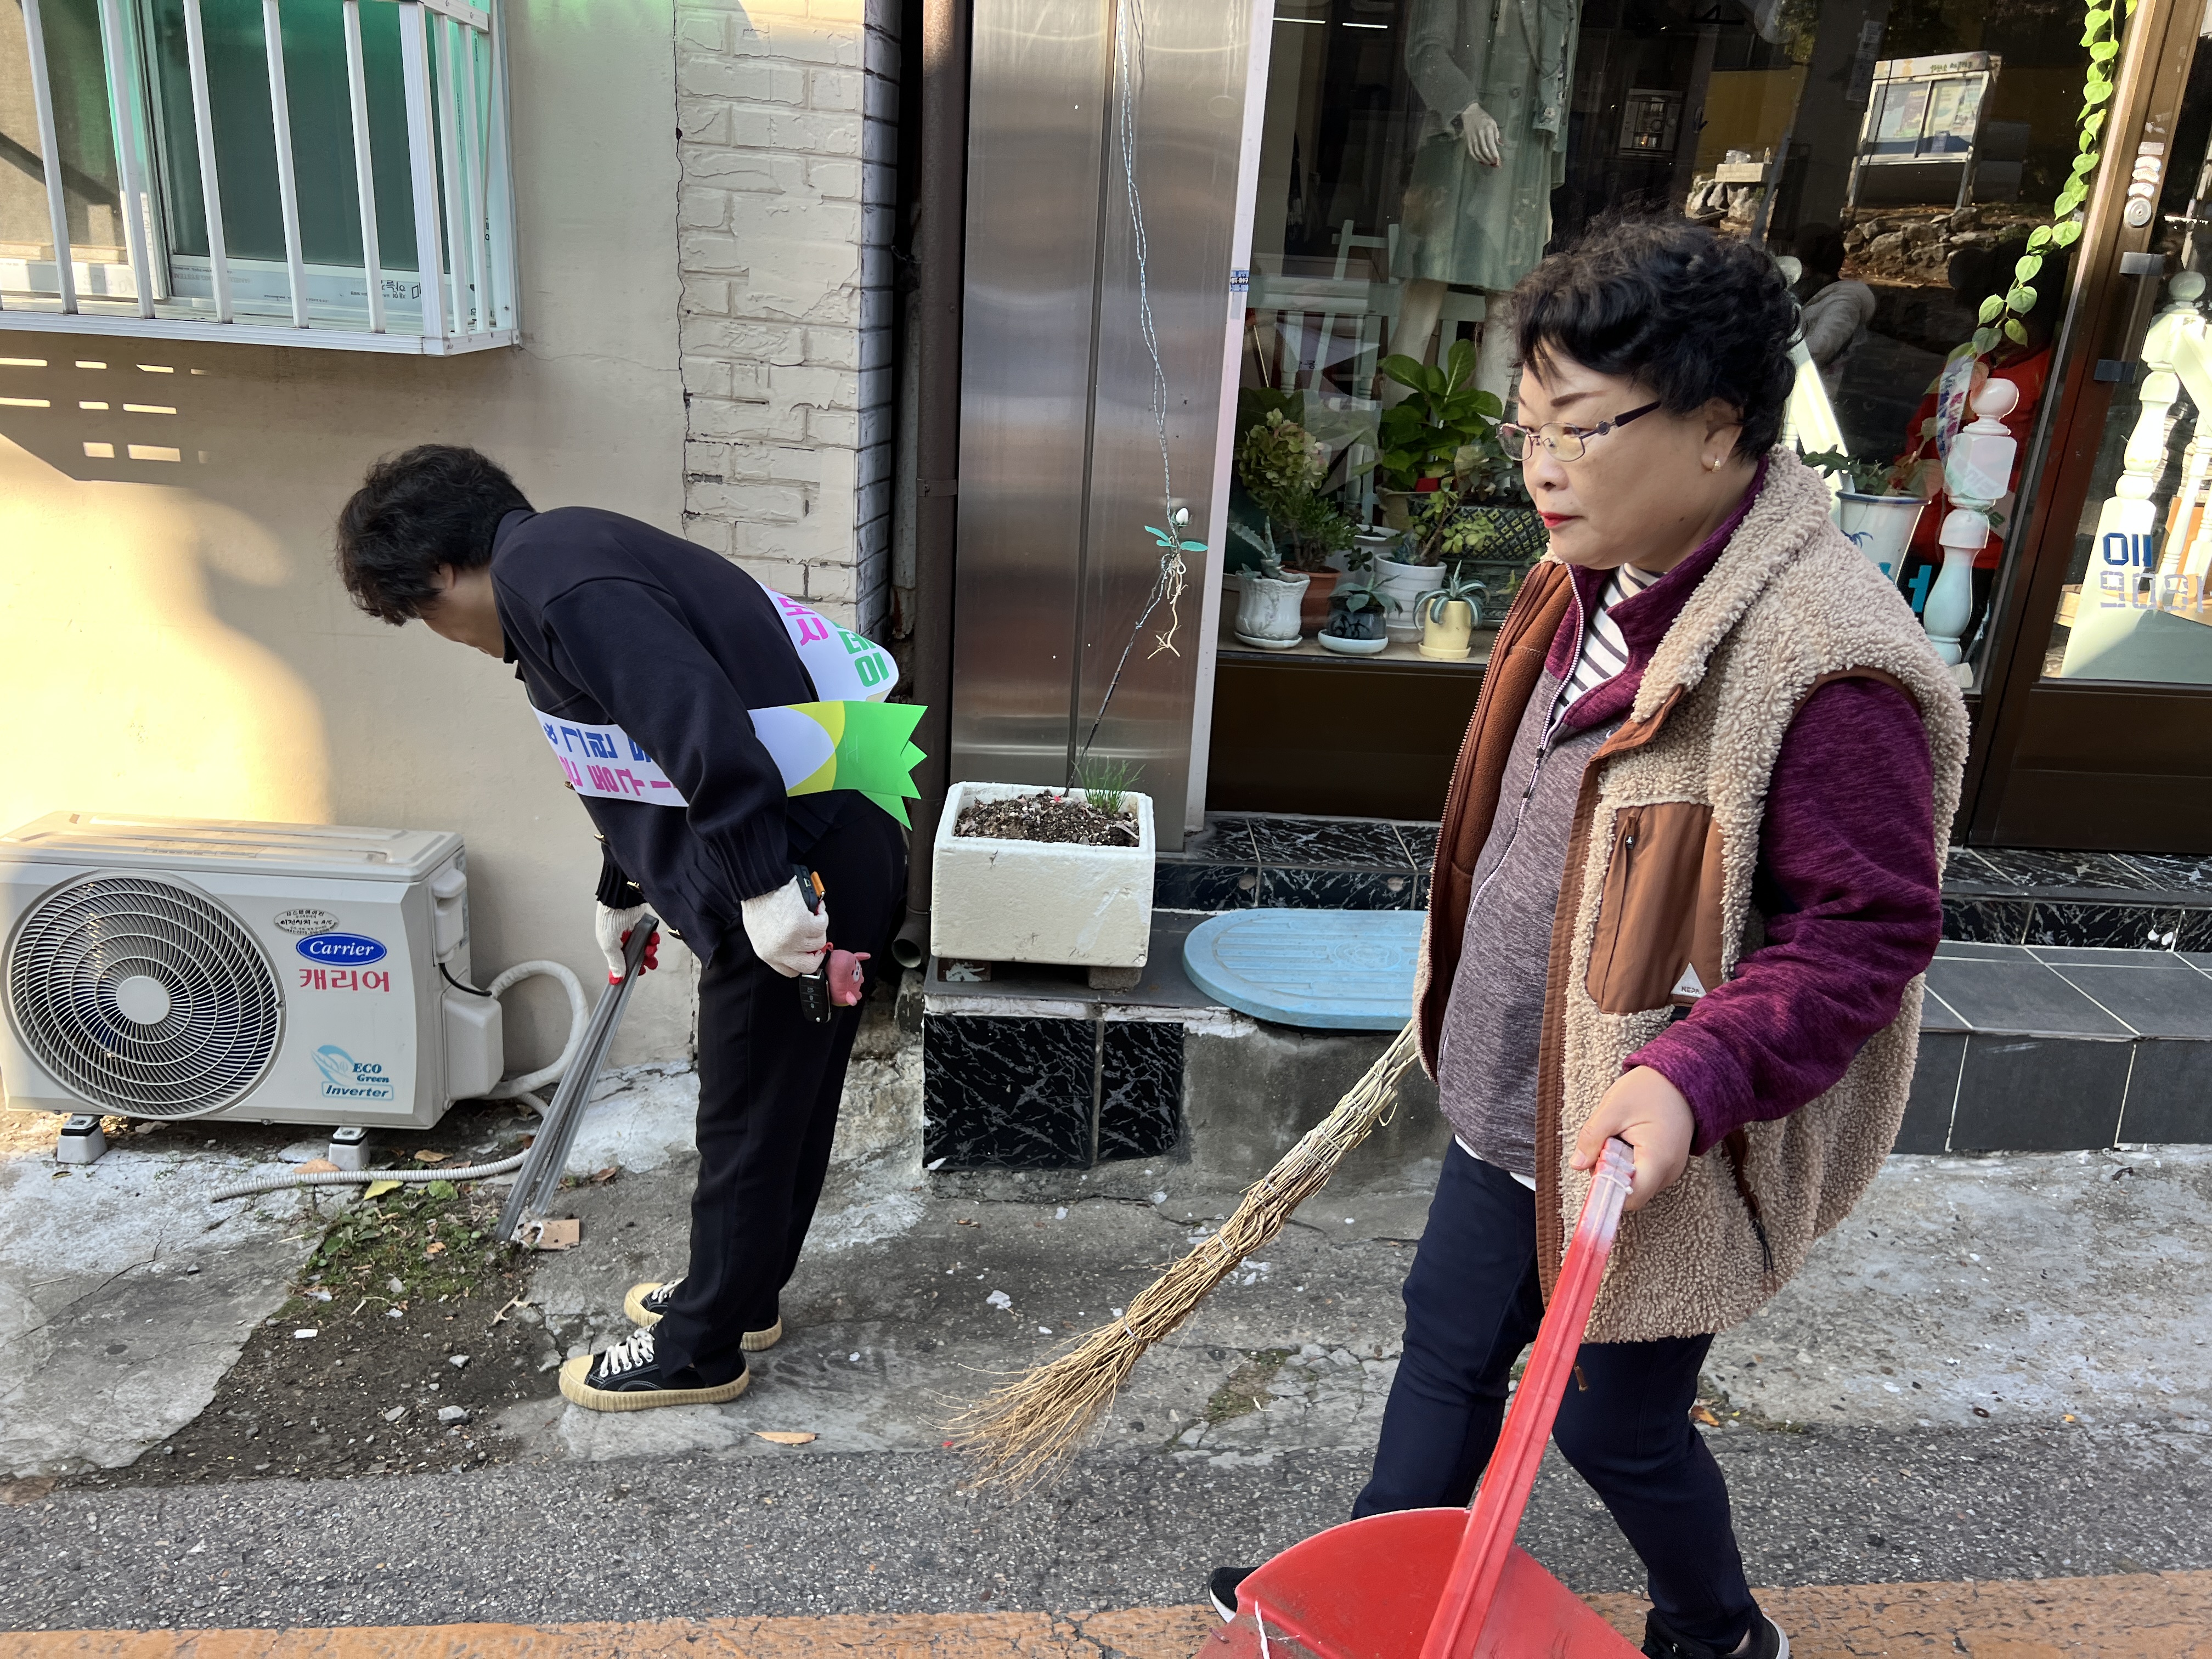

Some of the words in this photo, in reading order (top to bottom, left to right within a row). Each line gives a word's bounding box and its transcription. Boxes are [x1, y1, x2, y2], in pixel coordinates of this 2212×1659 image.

[777, 597, 829, 646] 도시
[829, 620, 889, 687] 데이
[560, 725, 618, 759] 그린
[309, 940, 374, 956] Carrier
[299, 969, 390, 992] 캐리어
[1681, 986, 1701, 995] NEPA
[352, 1063, 382, 1074] ECO
[357, 1074, 390, 1083] Green
[326, 1085, 389, 1097] Inverter
